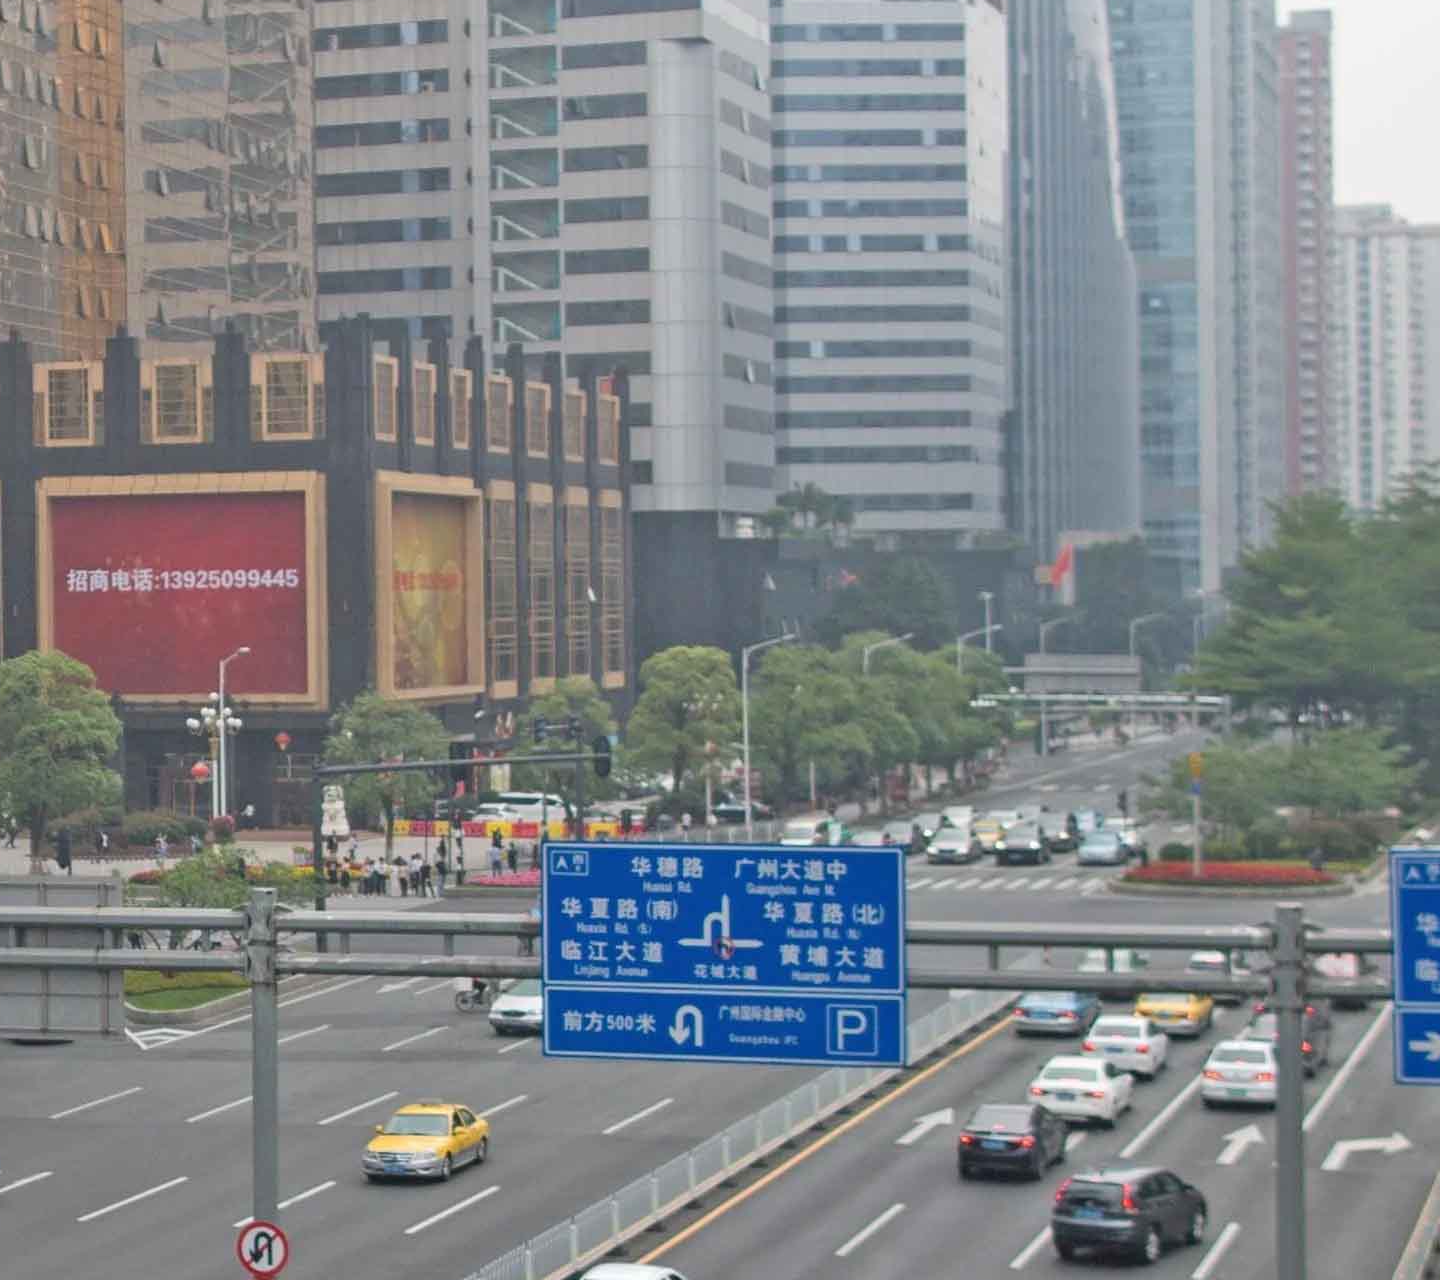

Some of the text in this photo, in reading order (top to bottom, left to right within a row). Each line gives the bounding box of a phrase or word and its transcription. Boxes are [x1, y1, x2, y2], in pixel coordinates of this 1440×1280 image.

[66, 568, 300, 593] 招商电话:13925099445
[734, 858, 848, 881] 广州大道中
[561, 939, 663, 963] 临江大道
[779, 944, 885, 969] 黄埔大道
[562, 1010, 657, 1035] 前方500米
[836, 1010, 868, 1051] P
